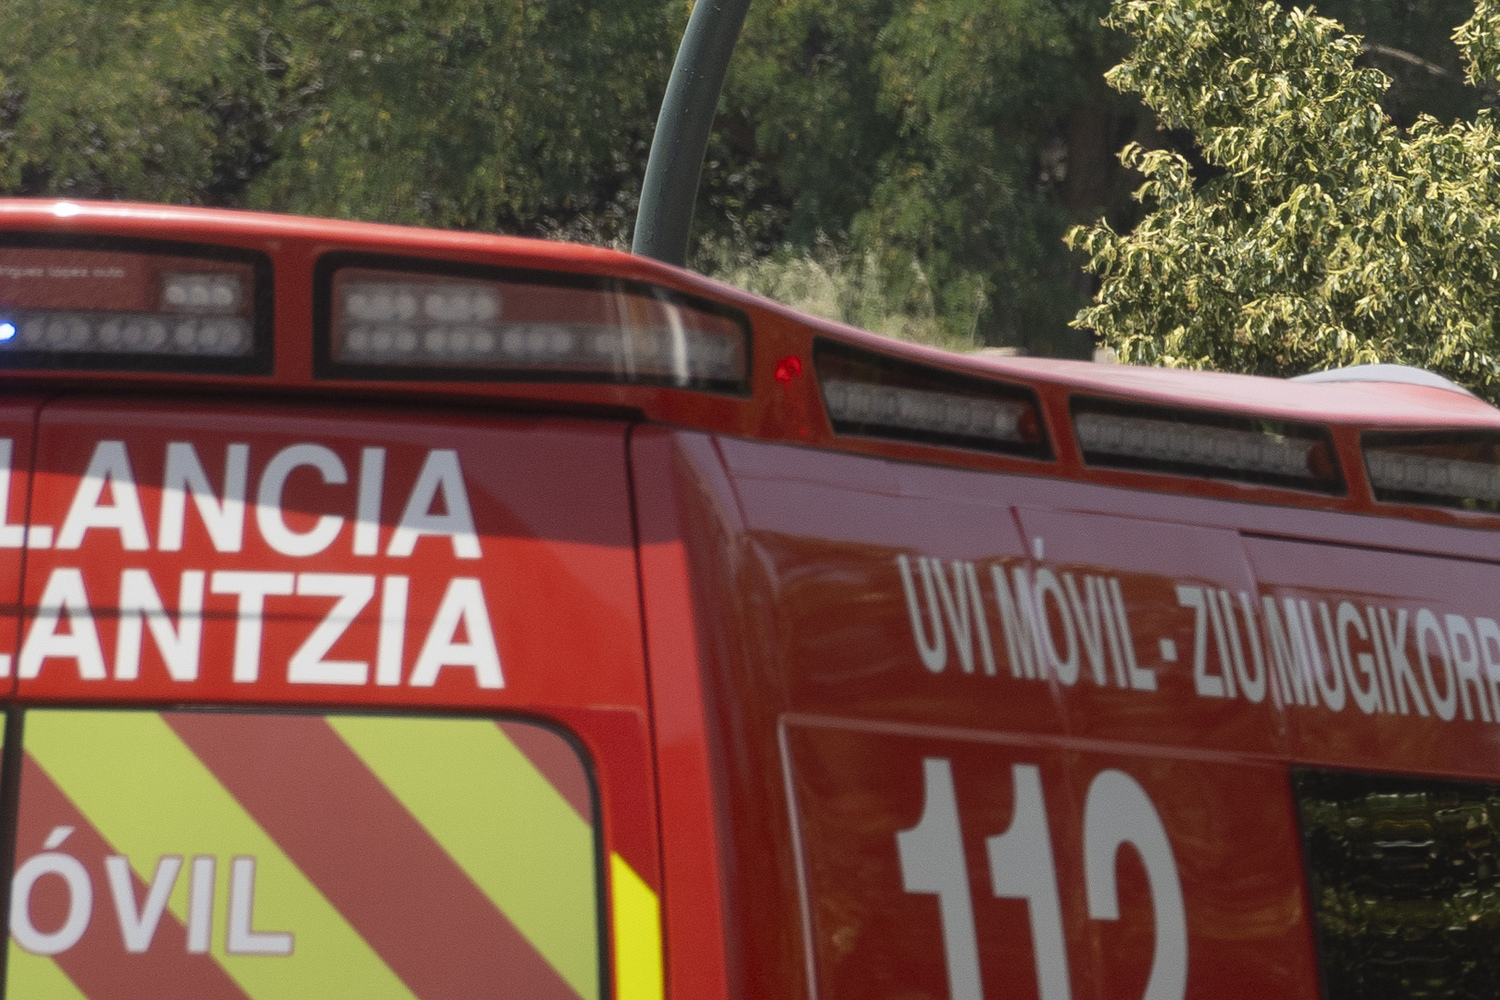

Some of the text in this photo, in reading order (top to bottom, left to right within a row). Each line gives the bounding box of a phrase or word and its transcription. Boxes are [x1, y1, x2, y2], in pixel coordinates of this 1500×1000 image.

[0, 566, 506, 689] ANTZIA
[898, 553, 997, 677] UVI
[991, 537, 1159, 692] MÓVIL
[1175, 584, 1267, 704] ZIU
